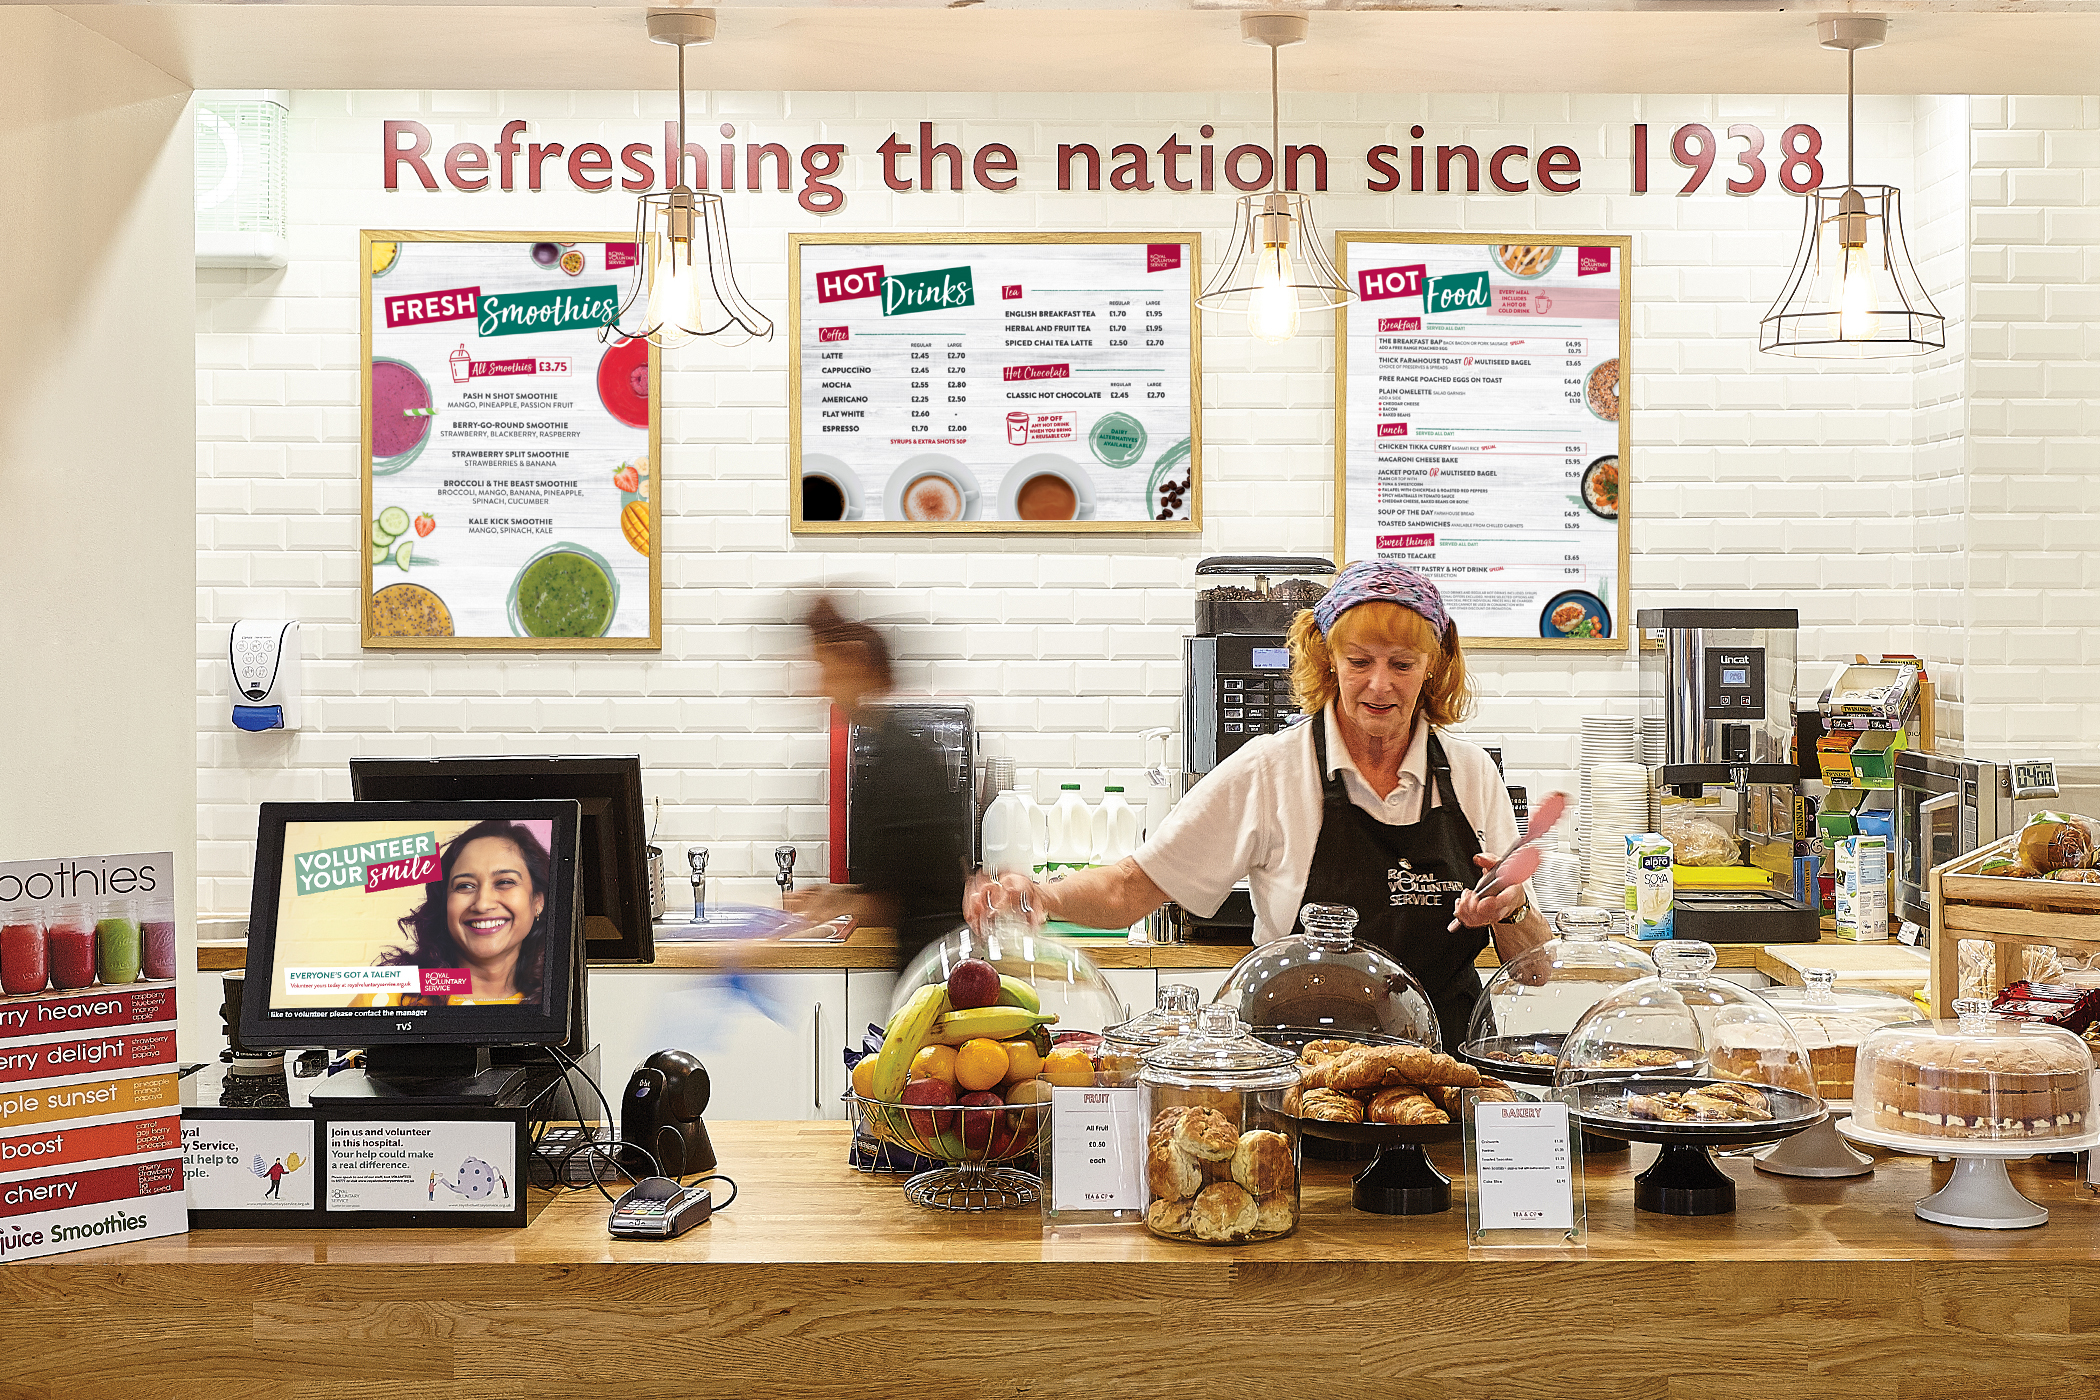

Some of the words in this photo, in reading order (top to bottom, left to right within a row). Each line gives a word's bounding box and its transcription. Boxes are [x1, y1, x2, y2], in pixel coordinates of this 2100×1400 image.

[383, 119, 847, 214] Refreshing
[876, 120, 1019, 192] the
[1057, 124, 1328, 192] nation
[1366, 124, 1583, 192] since
[1629, 122, 1825, 197] 1938
[824, 272, 877, 297] HOT
[881, 274, 972, 315] Drinks
[1005, 287, 1019, 297] Tea
[1365, 271, 1419, 296] HOT
[1426, 276, 1489, 312] Food
[391, 292, 476, 322] FRESH
[478, 296, 613, 336] Smoothies
[1379, 319, 1420, 332] Breakfast
[820, 327, 848, 342] Coffee
[1463, 357, 1473, 366] OR
[471, 364, 486, 377] All
[489, 362, 533, 377] Smoothies
[539, 360, 567, 373] £3.75
[1004, 366, 1023, 380] Hot
[1024, 368, 1068, 380] Chocolate
[447, 401, 478, 409] MANGO,
[479, 401, 519, 409] PINEAPPLE,
[520, 401, 552, 409] PASSION
[553, 401, 574, 409] FRUIT
[1379, 424, 1406, 435] Lunch
[535, 480, 578, 488] SMOOTHIE
[1377, 536, 1404, 548] Sweet
[1405, 534, 1434, 547] things
[298, 836, 429, 872] VOLUNTEER
[1644, 857, 1668, 868] alpro
[299, 867, 363, 891] YOUR
[369, 853, 435, 888] smile
[1387, 868, 1438, 884] ROYAL
[1644, 873, 1669, 885] SOYA
[1389, 893, 1443, 906] SERVICE
[290, 971, 342, 979] EVERYONE'S
[343, 971, 361, 979] GOT
[370, 970, 401, 978] TALENT
[425, 972, 450, 981] ROYAL
[425, 978, 467, 986] VOLUNTARY
[38, 1000, 123, 1022] heaven
[329, 1010, 353, 1019] please
[395, 1009, 428, 1019] manager
[131, 1035, 169, 1045] strawberry
[47, 1039, 125, 1064] delight
[47, 1083, 118, 1109] sunset
[1083, 1093, 1110, 1104] FRUIT
[1501, 1108, 1542, 1118] BAKERY
[331, 1128, 349, 1138] Join
[365, 1128, 383, 1136] and
[1, 1134, 64, 1160] boost
[192, 1141, 239, 1152] Service,
[343, 1139, 360, 1147] this
[363, 1139, 403, 1148] hospital.
[197, 1155, 224, 1166] help
[226, 1156, 239, 1164] to
[332, 1150, 355, 1158] Your
[356, 1150, 377, 1160] help
[378, 1150, 406, 1158] could
[408, 1150, 434, 1158] make
[4, 1181, 78, 1205] cherry
[50, 1211, 148, 1243] Smoothies
